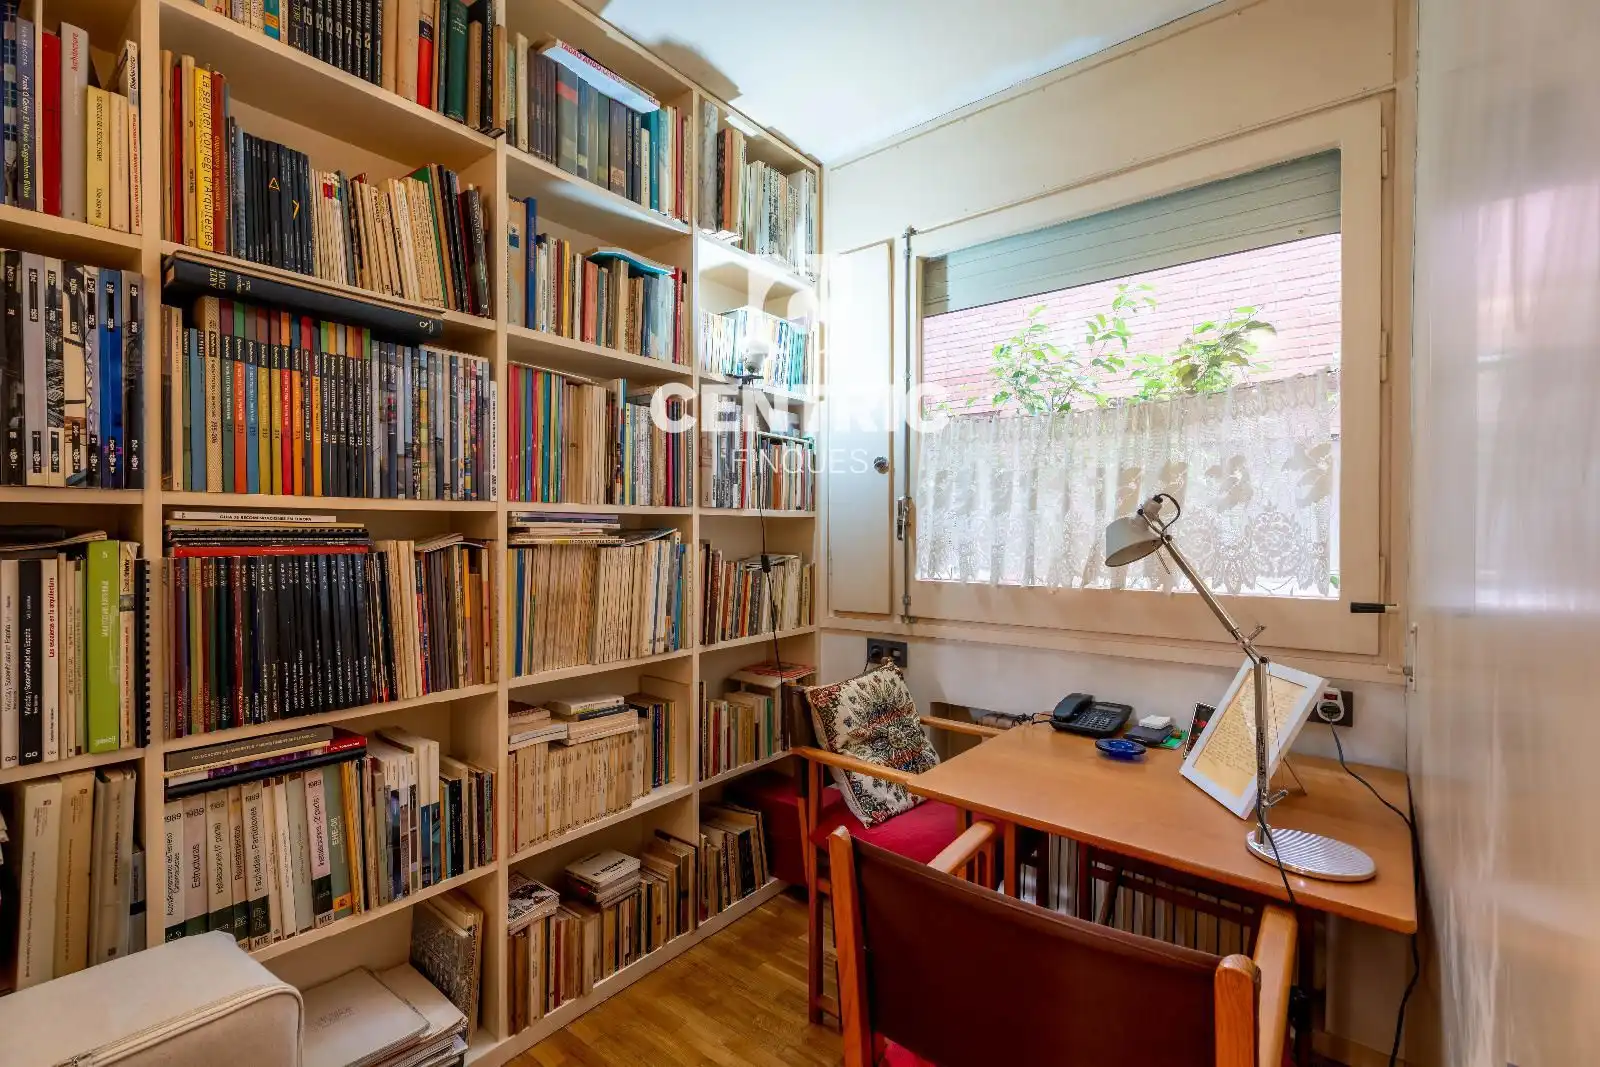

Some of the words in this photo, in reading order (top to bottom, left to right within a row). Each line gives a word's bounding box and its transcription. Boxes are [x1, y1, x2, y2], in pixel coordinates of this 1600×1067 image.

[303, 7, 312, 25] 15
[336, 22, 342, 39] 9
[346, 27, 352, 44] 7
[364, 32, 370, 49] 2
[202, 75, 211, 88] La
[209, 268, 217, 288] ARTE
[191, 844, 200, 888] Estructuras
[319, 913, 333, 924] NTE
[254, 935, 269, 947] NTE
